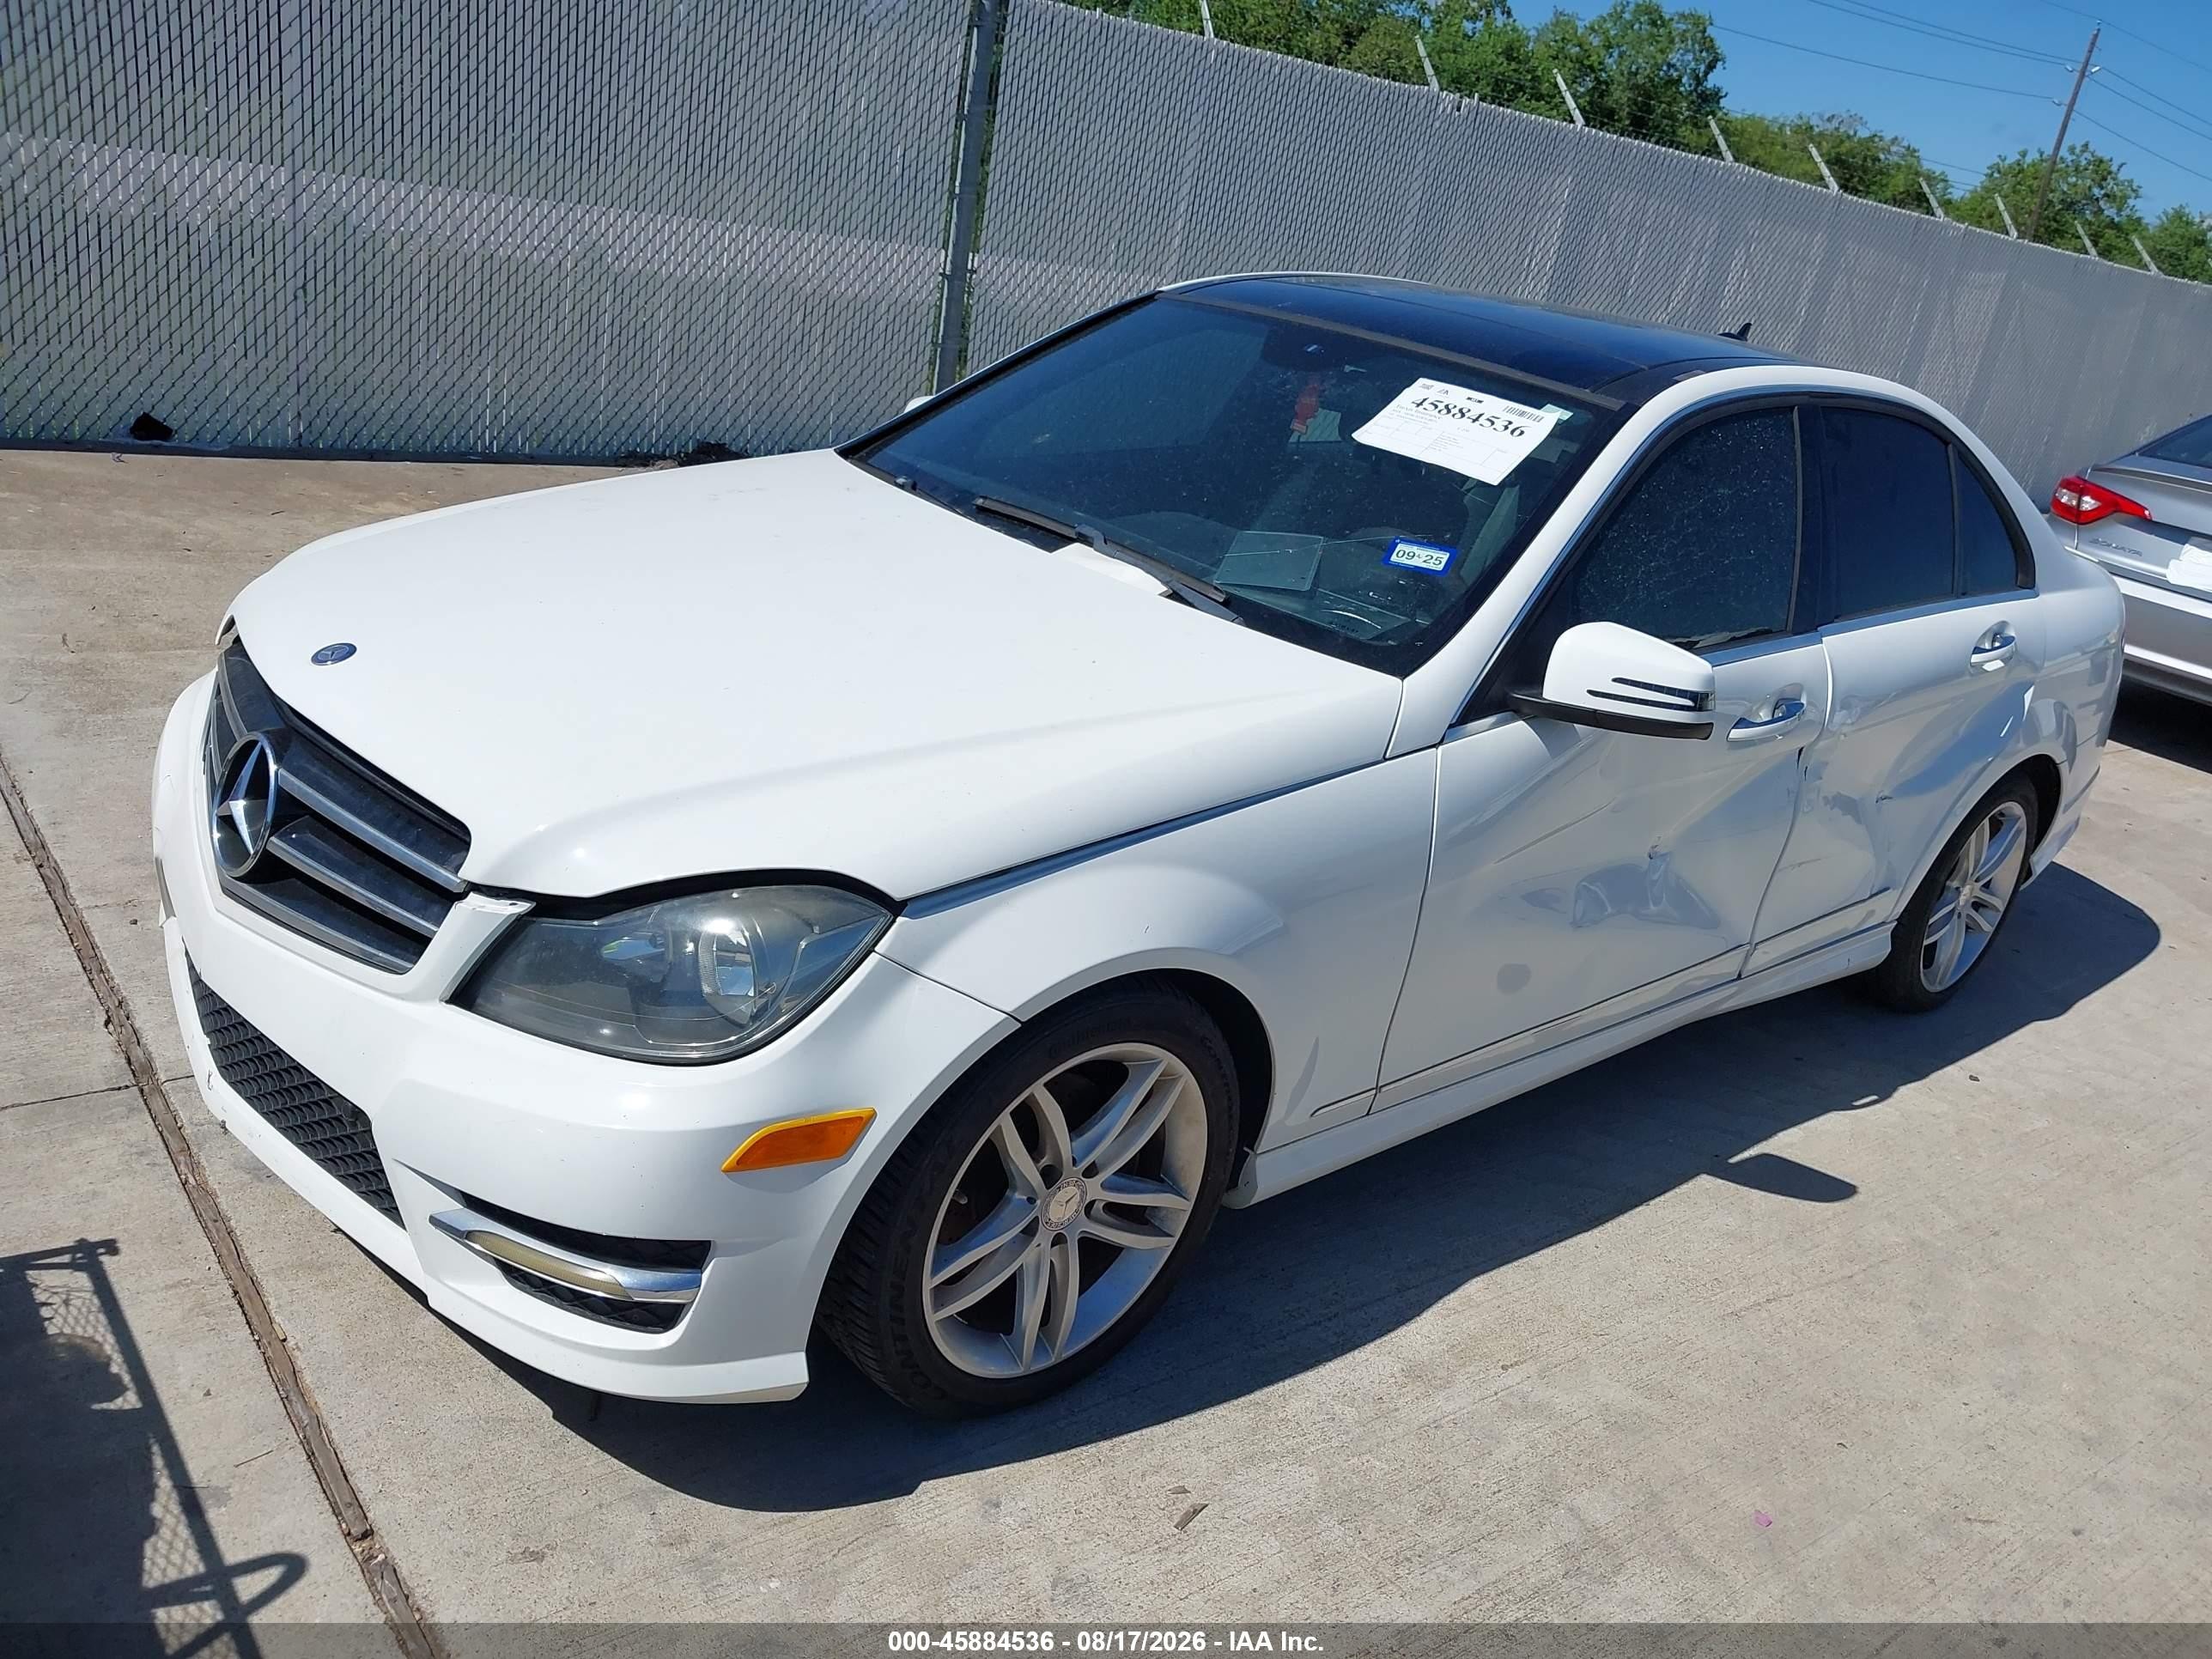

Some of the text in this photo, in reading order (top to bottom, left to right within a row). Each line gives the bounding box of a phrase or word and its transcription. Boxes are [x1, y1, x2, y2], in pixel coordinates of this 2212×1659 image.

[1411, 396, 1532, 439] 45884536
[1395, 549, 1416, 561] 09
[1422, 554, 1444, 566] 25
